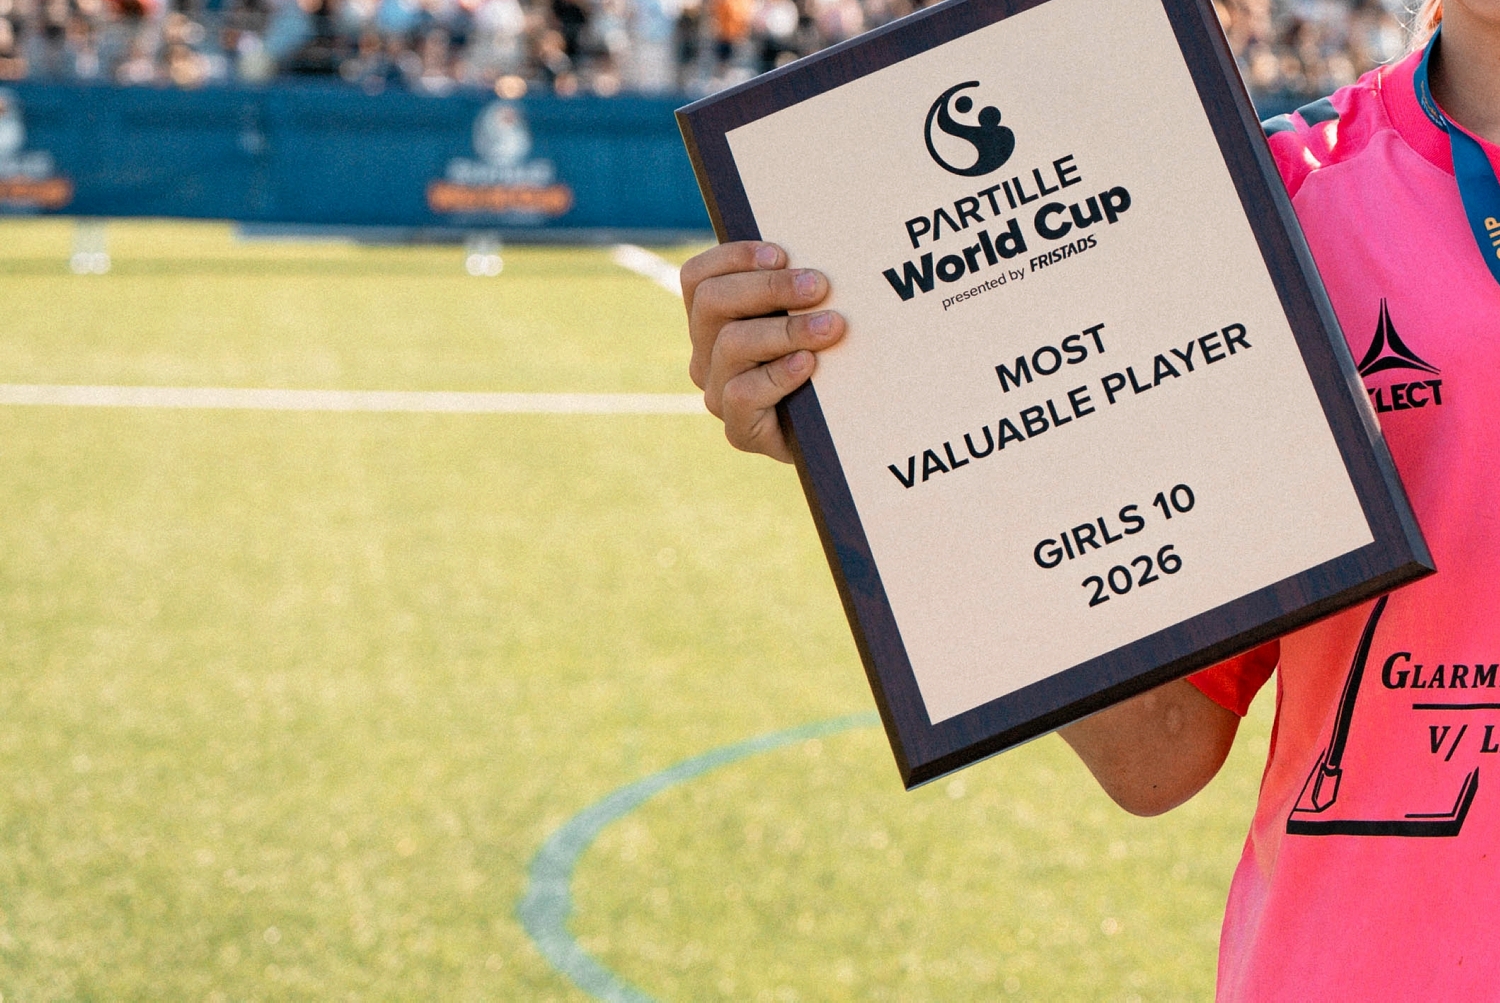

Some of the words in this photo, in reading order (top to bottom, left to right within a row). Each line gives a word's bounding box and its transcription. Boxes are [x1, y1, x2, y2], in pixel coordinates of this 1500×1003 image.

[882, 218, 1028, 301] World
[1034, 186, 1132, 240] Cup
[905, 154, 1082, 249] PARTILLE
[942, 273, 1007, 311] presented
[1008, 267, 1025, 285] by
[1029, 234, 1098, 273] FRISTADS
[995, 323, 1105, 393] MOST
[888, 385, 1095, 488] VALUABLE
[1101, 323, 1252, 405] PLAYER
[1034, 505, 1145, 569] GIRLS
[1153, 484, 1195, 520] 10
[1081, 544, 1183, 608] 2026
